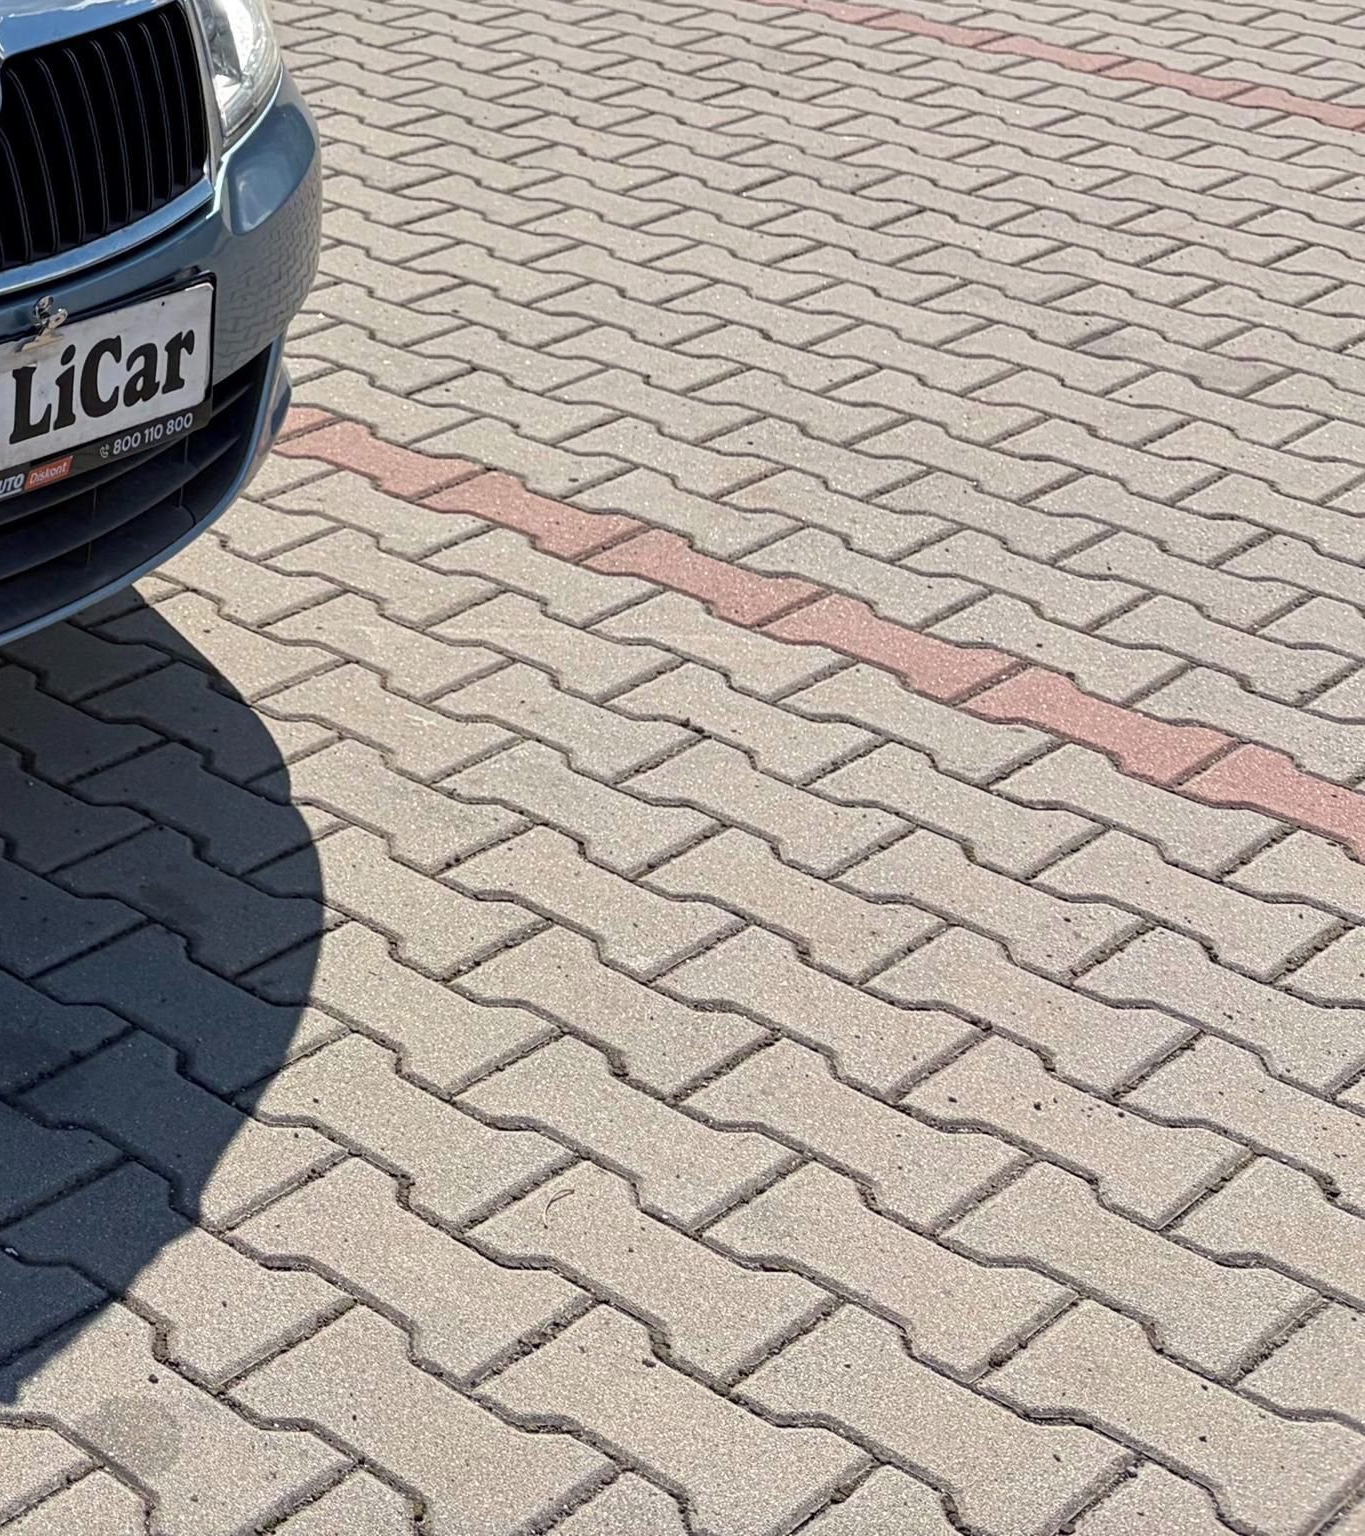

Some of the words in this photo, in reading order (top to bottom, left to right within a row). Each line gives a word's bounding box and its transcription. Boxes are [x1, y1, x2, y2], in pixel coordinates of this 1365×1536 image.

[9, 329, 195, 445] LiCar
[113, 431, 141, 455] 800
[143, 423, 164, 444] 110
[165, 412, 194, 436] 800
[29, 462, 68, 485] Diskont
